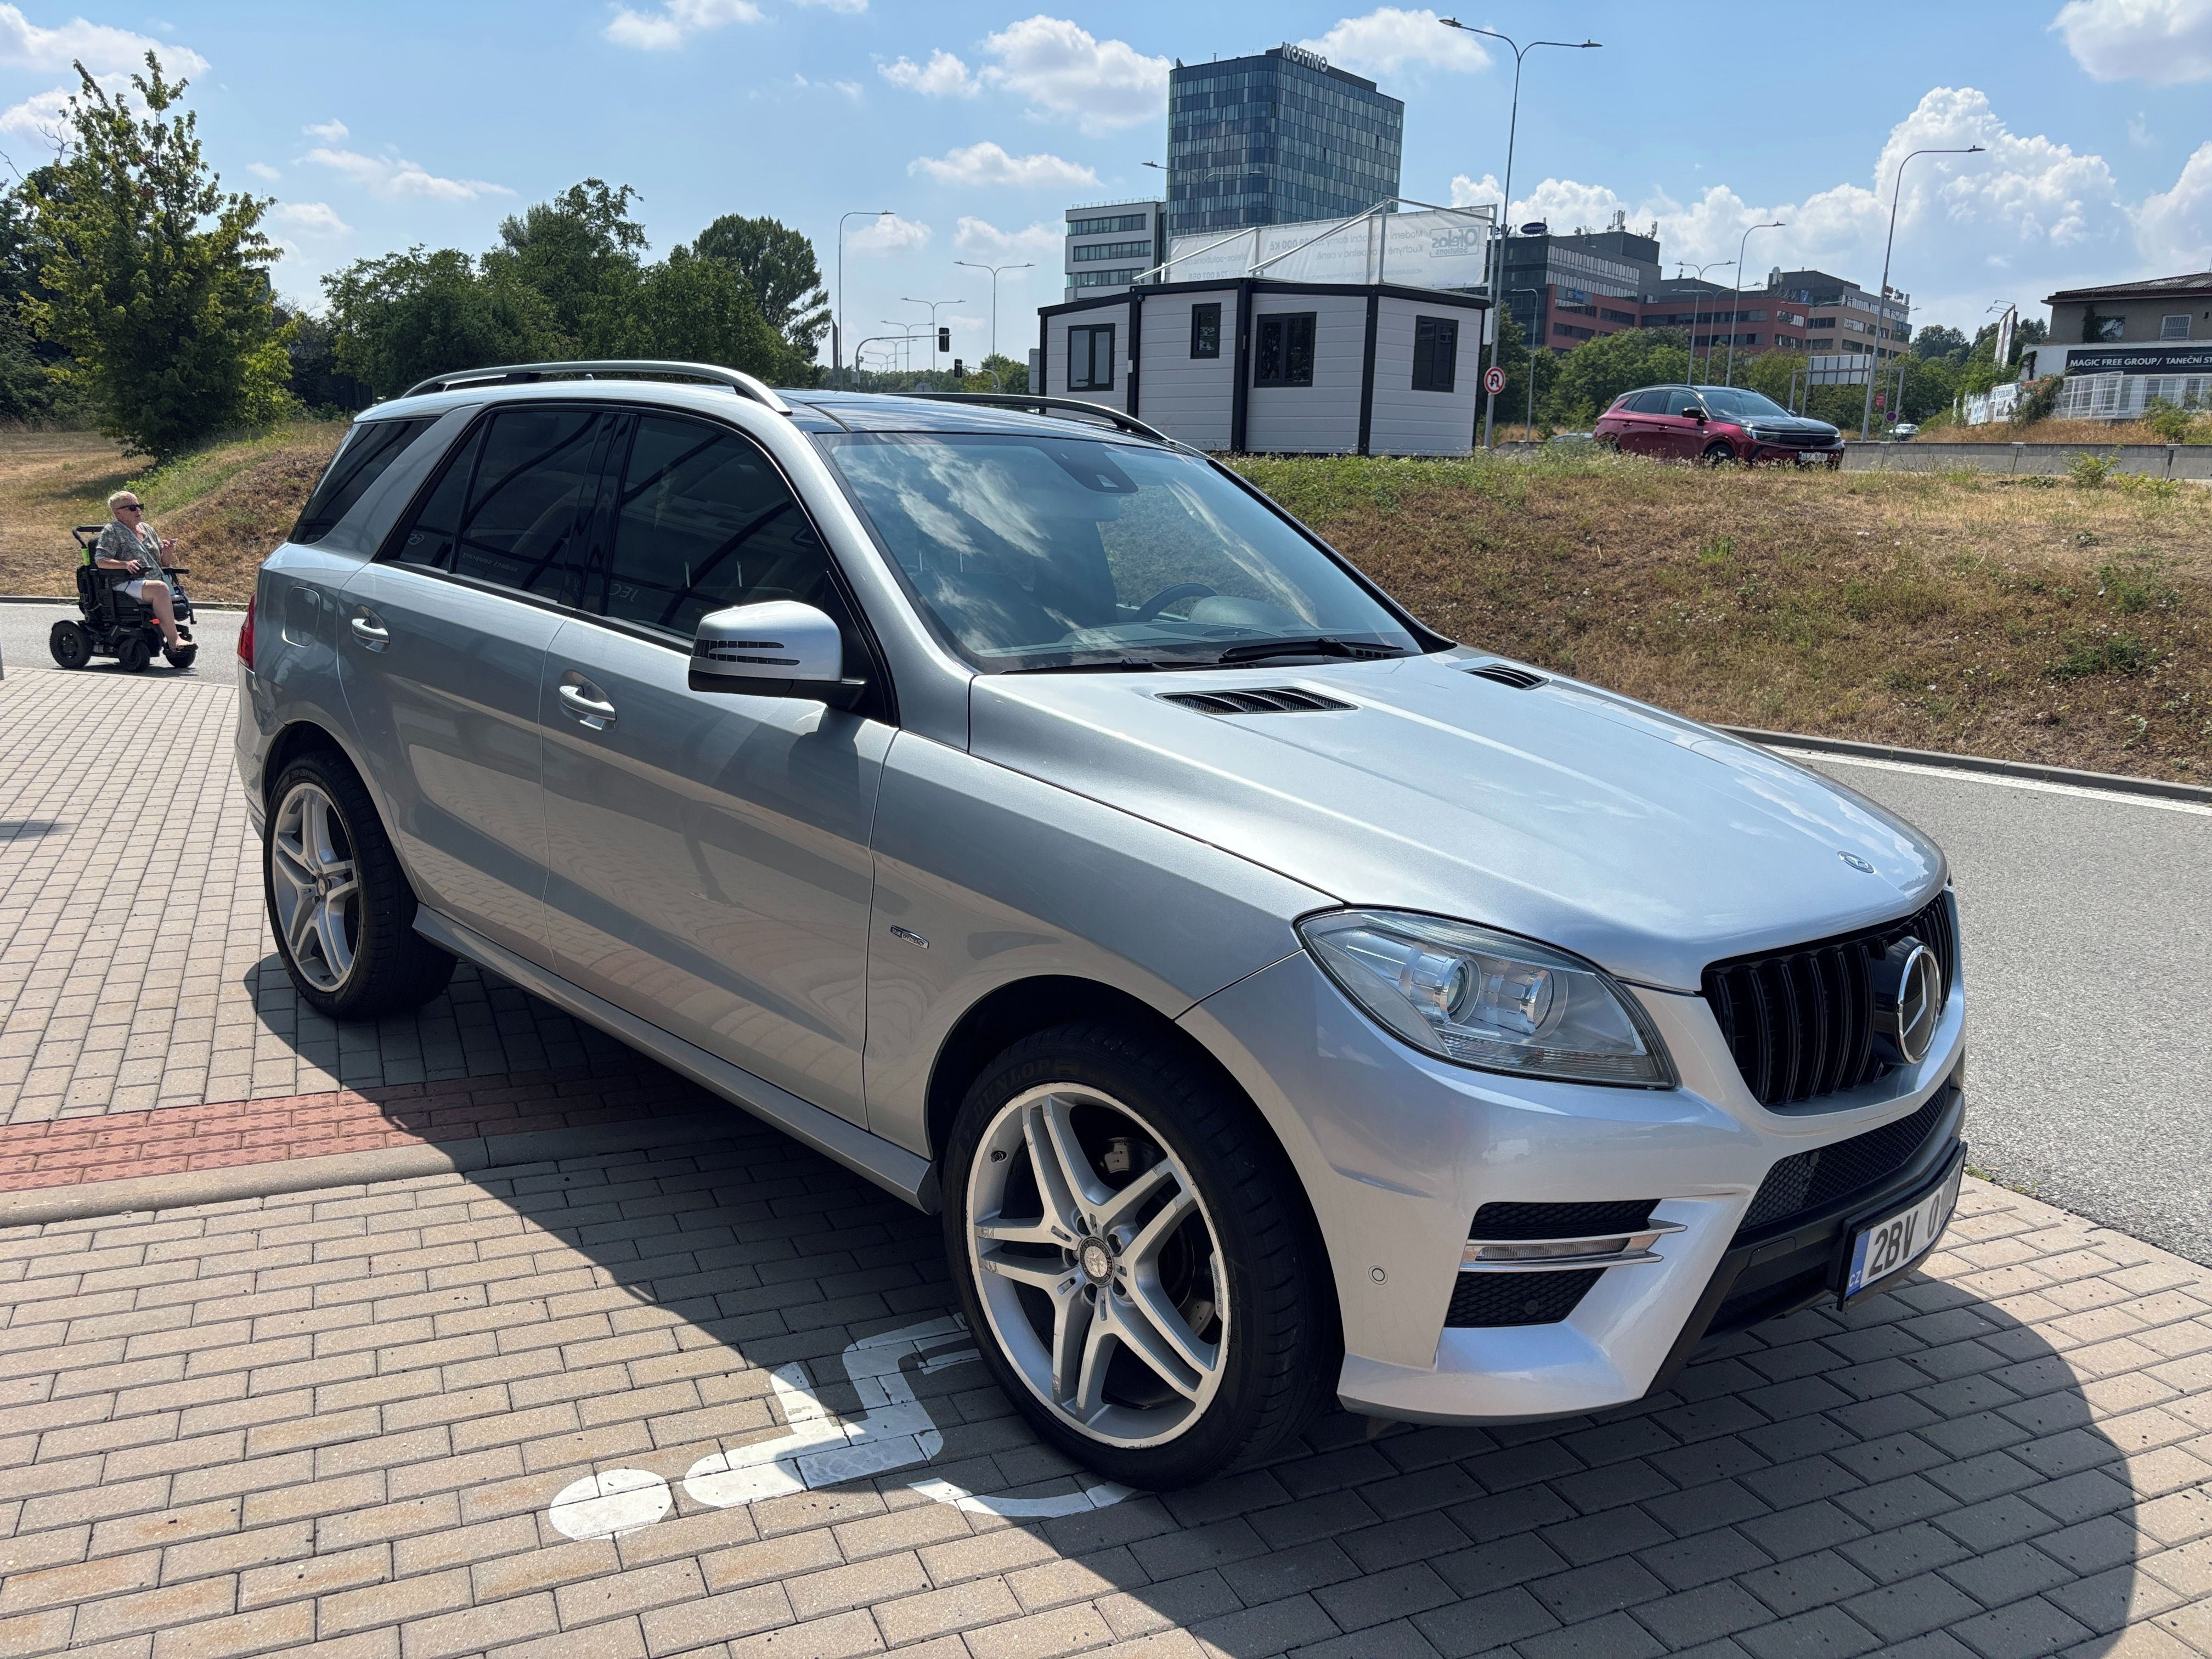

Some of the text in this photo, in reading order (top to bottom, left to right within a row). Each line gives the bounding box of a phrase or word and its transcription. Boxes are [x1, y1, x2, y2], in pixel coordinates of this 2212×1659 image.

[1282, 41, 1328, 72] NOTINO
[2101, 358, 2122, 366] FREE
[2165, 356, 2203, 364] TANEČNÍ
[892, 928, 925, 947] BLUE EFFICIENCY
[1867, 1210, 1918, 1278] 2BV
[1848, 1269, 1861, 1287] CZ
